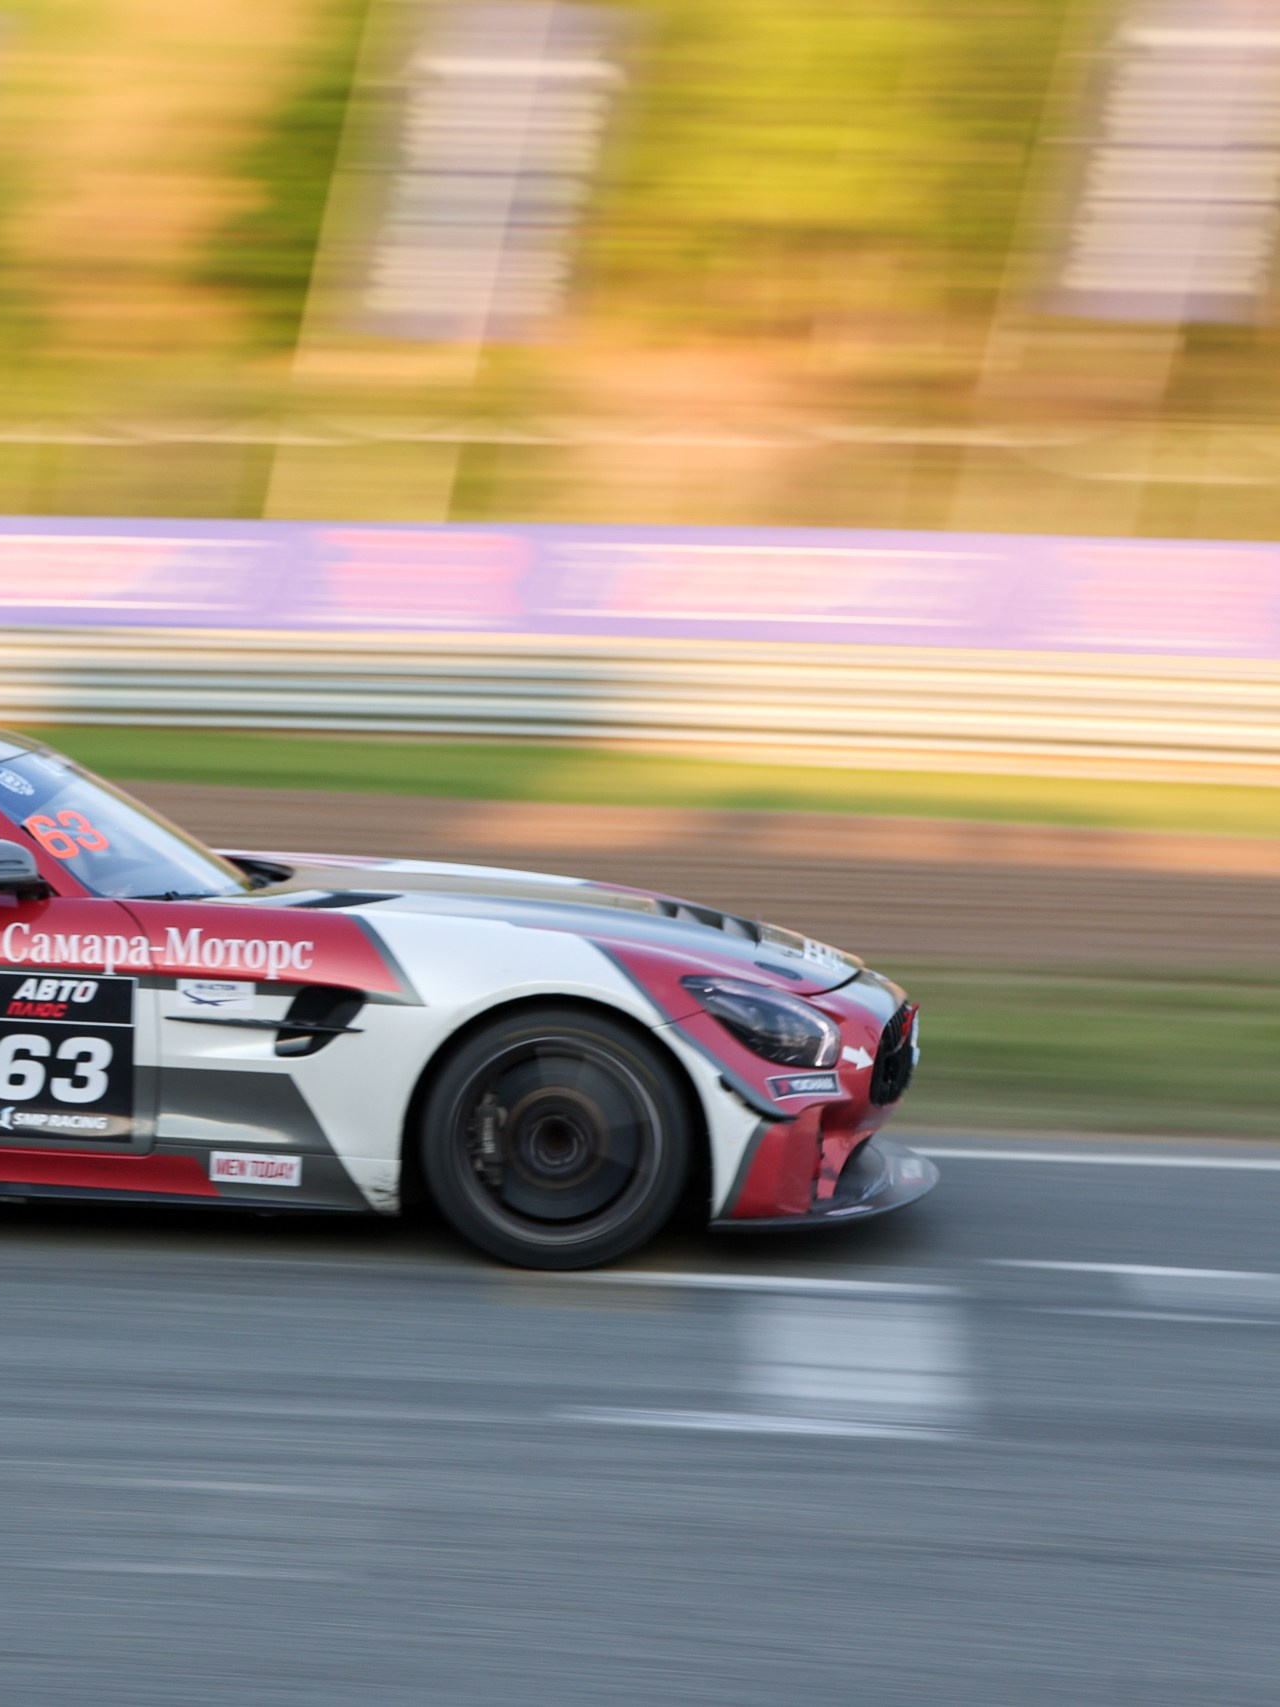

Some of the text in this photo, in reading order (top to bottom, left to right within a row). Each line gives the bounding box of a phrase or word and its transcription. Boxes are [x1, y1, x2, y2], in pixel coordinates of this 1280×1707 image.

[25, 810, 110, 860] 63
[2, 922, 315, 981] Самара-Моторс
[12, 977, 99, 1004] АВТО
[6, 1001, 69, 1019] ПЛЮС
[13, 1112, 108, 1130] SMP RACING
